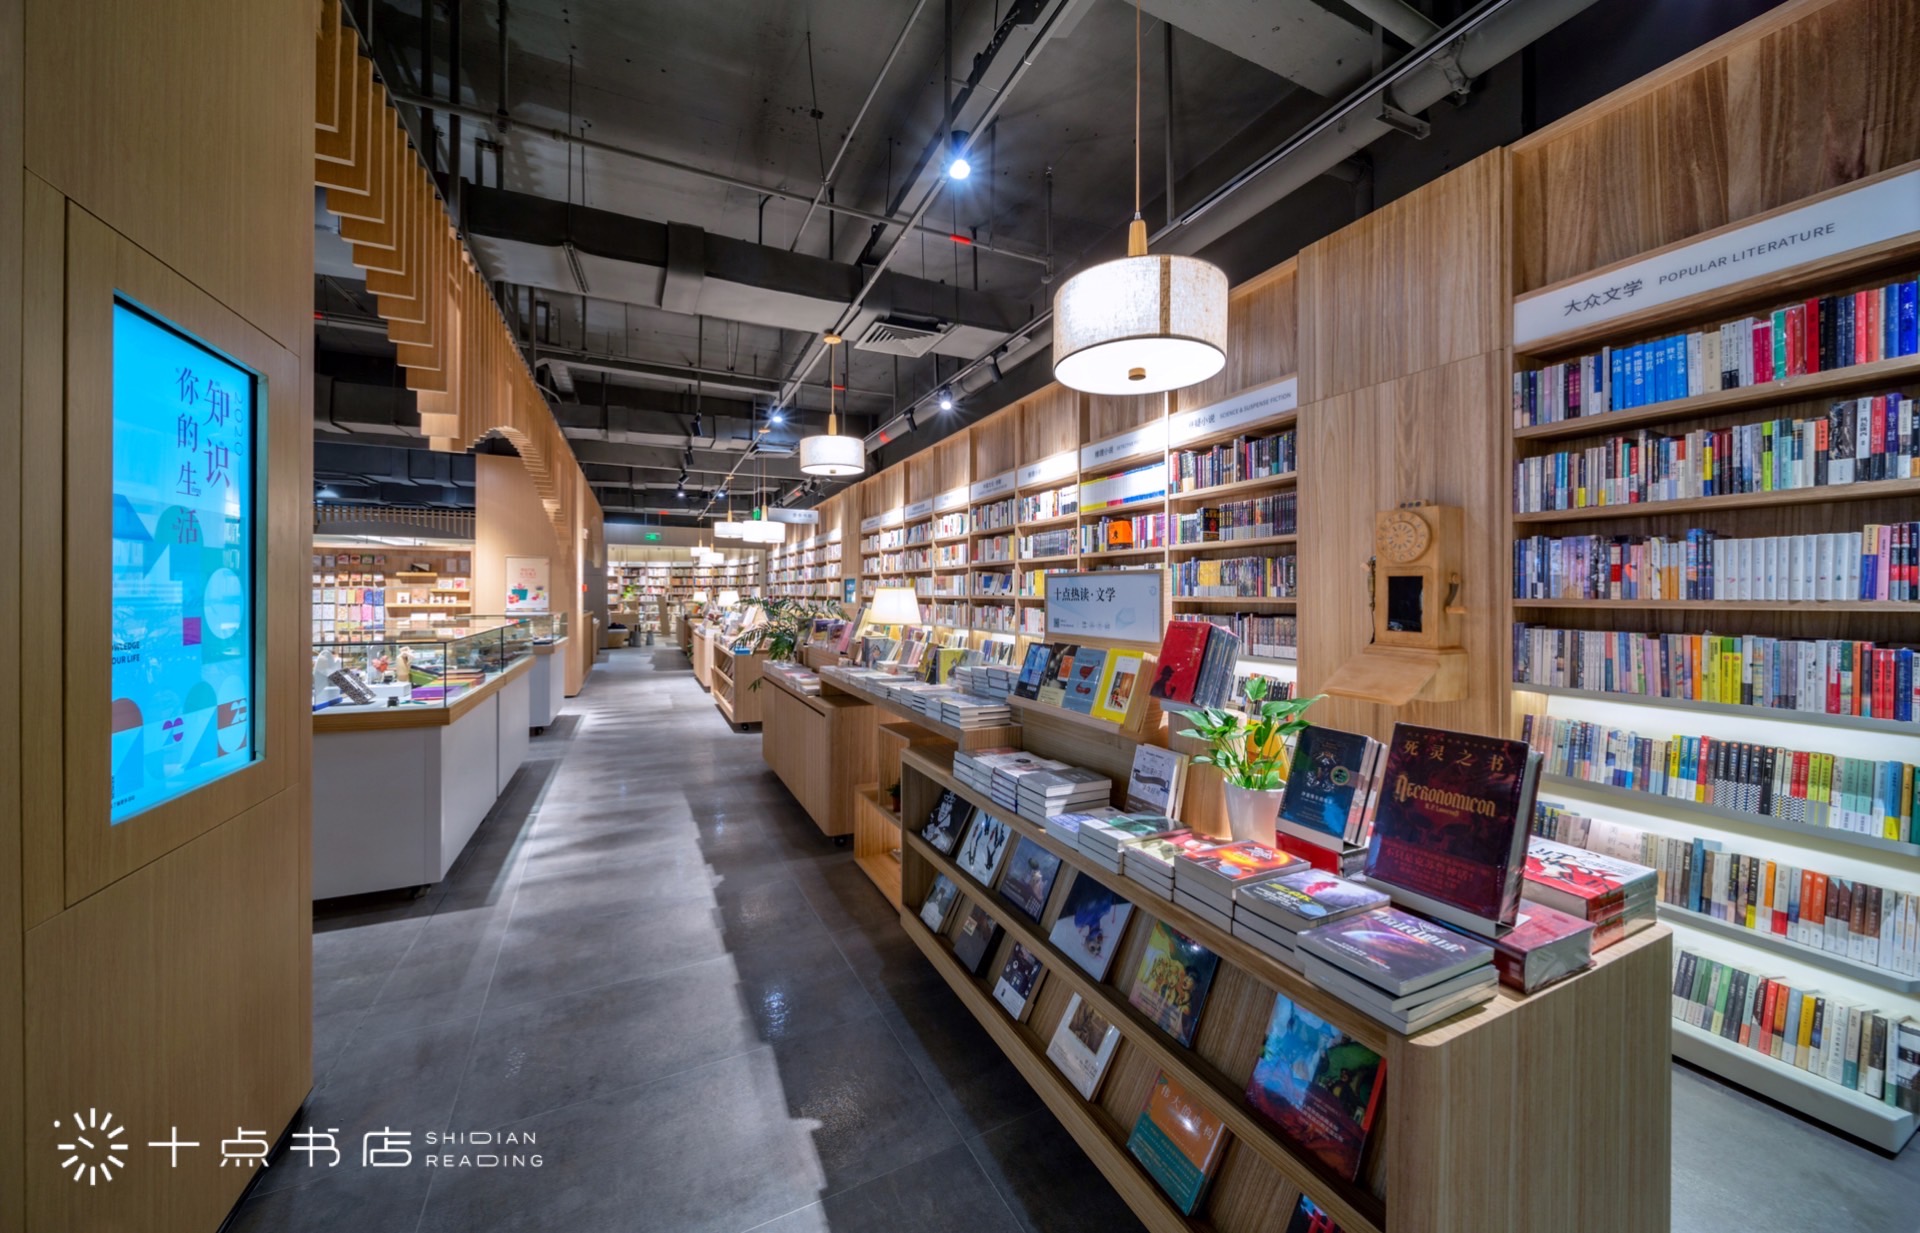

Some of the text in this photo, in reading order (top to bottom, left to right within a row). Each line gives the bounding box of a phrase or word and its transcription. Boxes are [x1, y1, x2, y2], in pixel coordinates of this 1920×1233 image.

[1658, 221, 1836, 285] POPULAR LITERATURE
[1563, 278, 1644, 317] 大众文学
[202, 379, 231, 488] 知识
[234, 391, 245, 457] 2020
[175, 367, 201, 545] 你的生活
[1054, 586, 1117, 602] 十点热读·文学
[127, 653, 140, 663] LIFE
[1403, 739, 1505, 772] 死灵之书
[1160, 1084, 1215, 1141] 伟大的虚构
